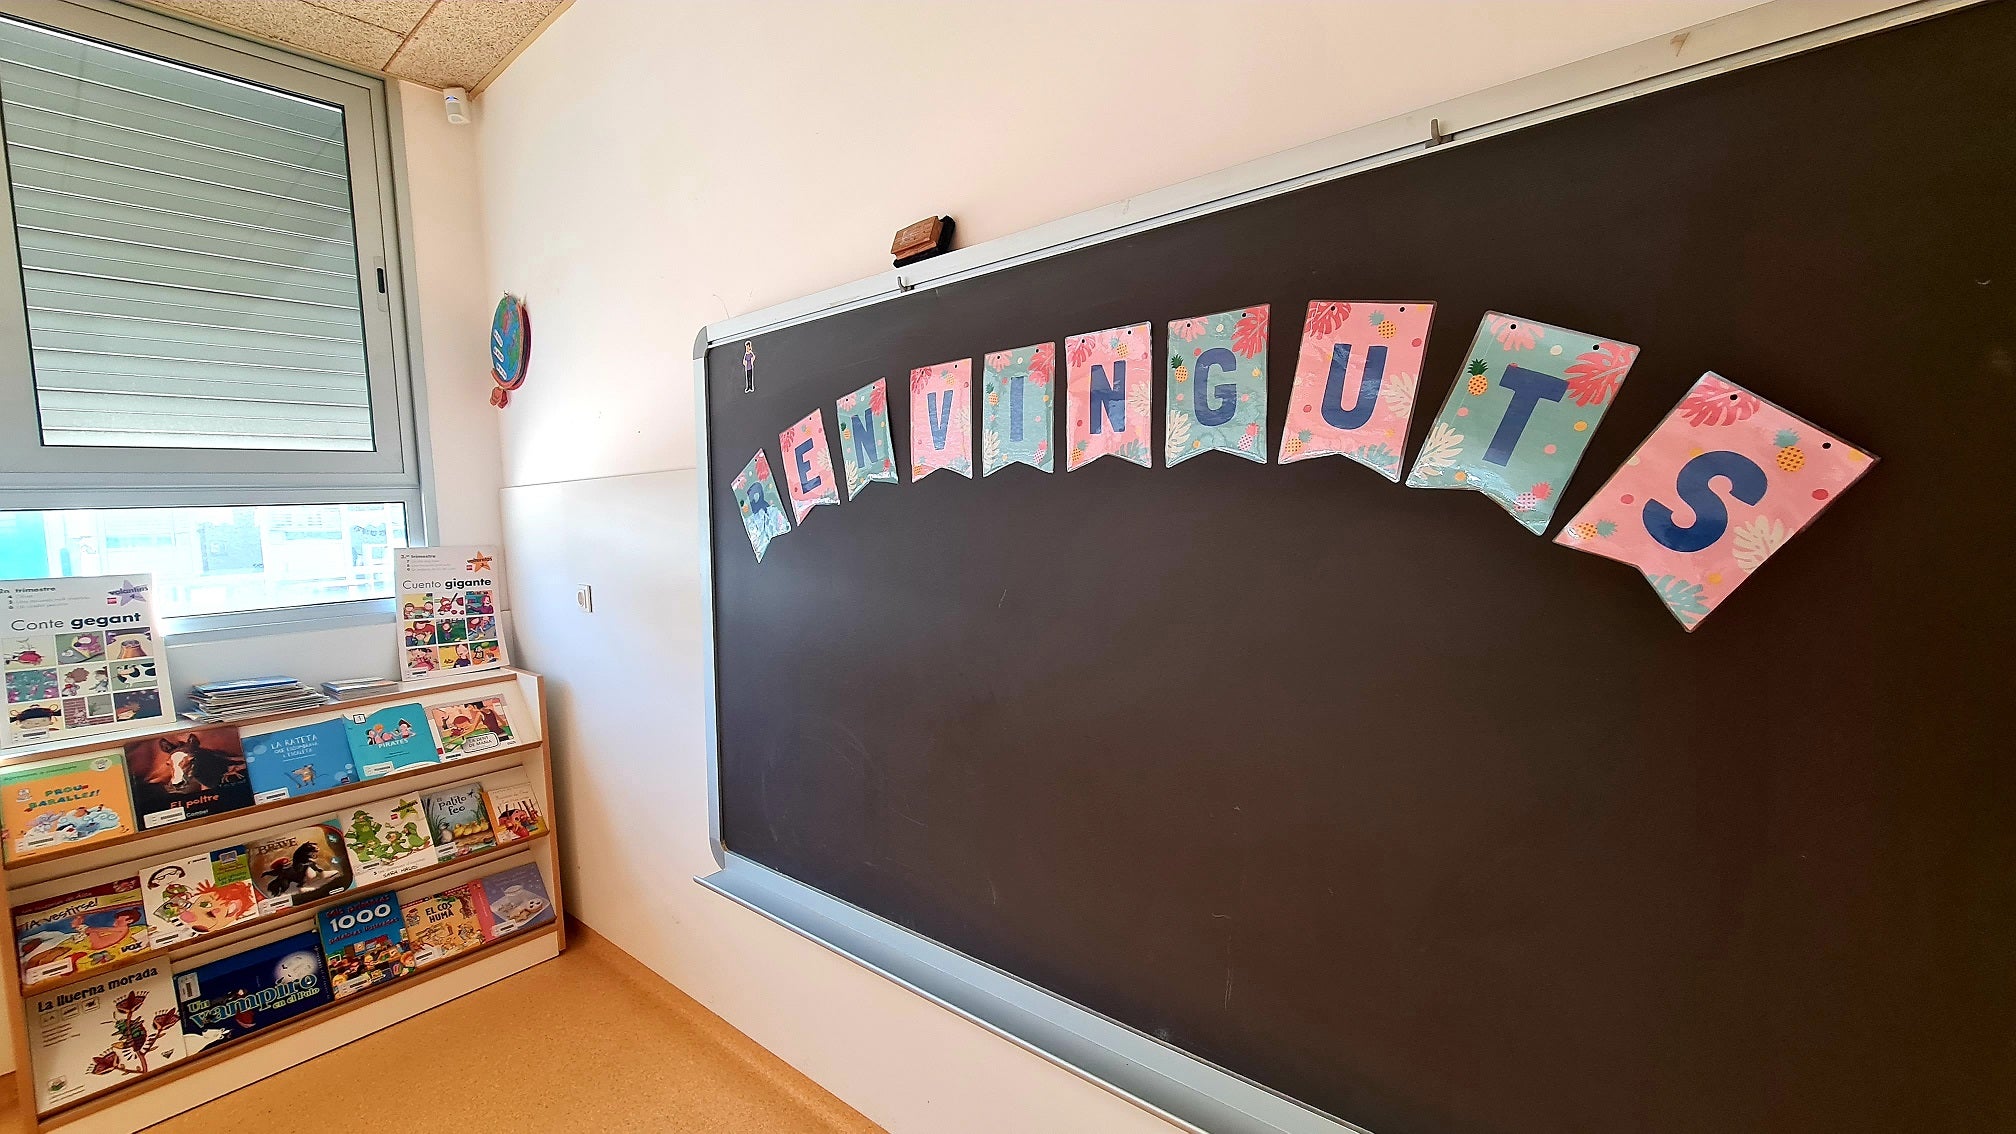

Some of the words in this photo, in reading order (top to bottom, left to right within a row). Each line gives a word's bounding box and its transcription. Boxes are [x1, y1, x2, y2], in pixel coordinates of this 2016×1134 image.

[402, 580, 441, 590] Cuento
[445, 578, 491, 589] gigante
[11, 619, 64, 631] Conte
[70, 612, 141, 629] gegant
[271, 741, 282, 749] LA
[378, 739, 409, 749] PIRATES
[45, 784, 82, 797] PROU
[186, 794, 220, 808] poltre
[438, 795, 467, 810] patito
[448, 805, 466, 816] feo
[256, 837, 298, 856] BRAVE
[425, 906, 437, 916] EL
[437, 901, 453, 912] COS
[329, 903, 392, 933] 1000
[38, 1000, 54, 1013] La
[57, 985, 105, 1008] lluerna
[108, 967, 158, 990] morada
[187, 999, 211, 1013] Un
[189, 973, 318, 1029] vampiro
